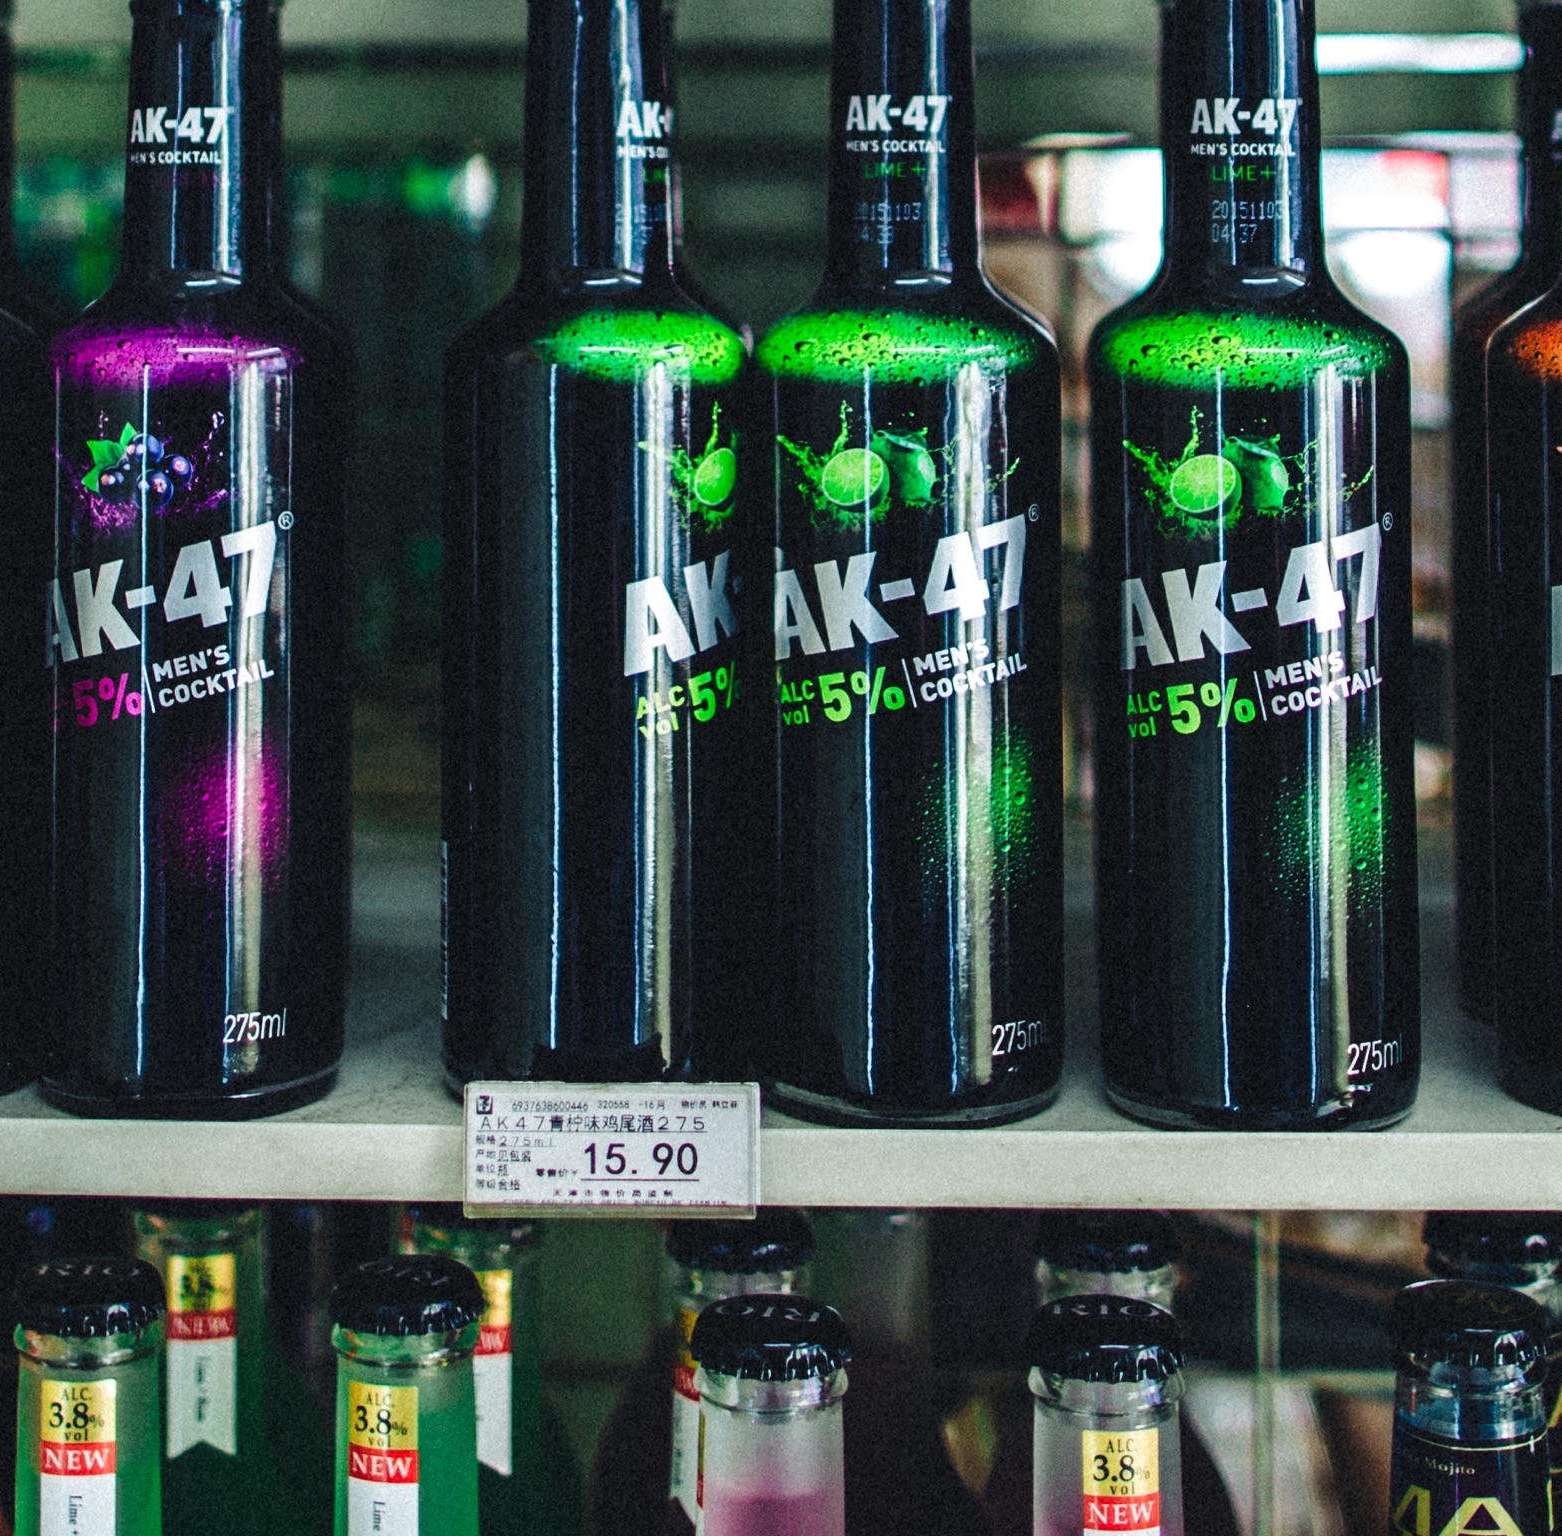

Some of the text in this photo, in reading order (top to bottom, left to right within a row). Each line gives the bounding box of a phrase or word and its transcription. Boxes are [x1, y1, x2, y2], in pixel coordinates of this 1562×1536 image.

[130, 106, 225, 145] AK-47
[846, 94, 948, 133] AK-47
[1190, 97, 1298, 135] AK-47
[157, 150, 222, 165] COCKTAIL
[881, 139, 947, 154] COCKTAIL
[1190, 143, 1296, 157] MEN'S COCKTAIL
[774, 513, 1027, 661] AK-47
[1120, 522, 1383, 671] AK-47
[624, 549, 741, 677] AK
[153, 644, 230, 683] MEN'S
[912, 637, 990, 677] MEN'S
[1264, 650, 1345, 689] MEN'S
[158, 658, 275, 709] COCKTAIL
[780, 679, 815, 704] ALC
[920, 652, 1028, 702] COCKTAIL
[1271, 665, 1383, 716] COCKTAIL
[73, 672, 143, 728] 5%
[636, 685, 686, 720] ALC
[819, 665, 905, 723] 5%
[1126, 690, 1162, 716] ALC
[1166, 677, 1257, 735] 5%
[639, 710, 680, 740] vol
[783, 705, 810, 726] vol
[1128, 716, 1157, 739] vol
[222, 1007, 288, 1044] 275ml
[1346, 1032, 1403, 1076] 275ml
[584, 1143, 699, 1176] 15.90
[48, 1402, 105, 1430] 3.8%
[354, 1404, 408, 1436] 3.8%
[64, 1428, 88, 1441] vol
[367, 1435, 391, 1448] vol
[44, 1448, 109, 1470] NEW
[351, 1450, 413, 1480] NEW
[1109, 1483, 1136, 1495] vol
[69, 1494, 83, 1525] Lime
[372, 1500, 386, 1532] Lime
[1088, 1500, 1155, 1524] NEW
